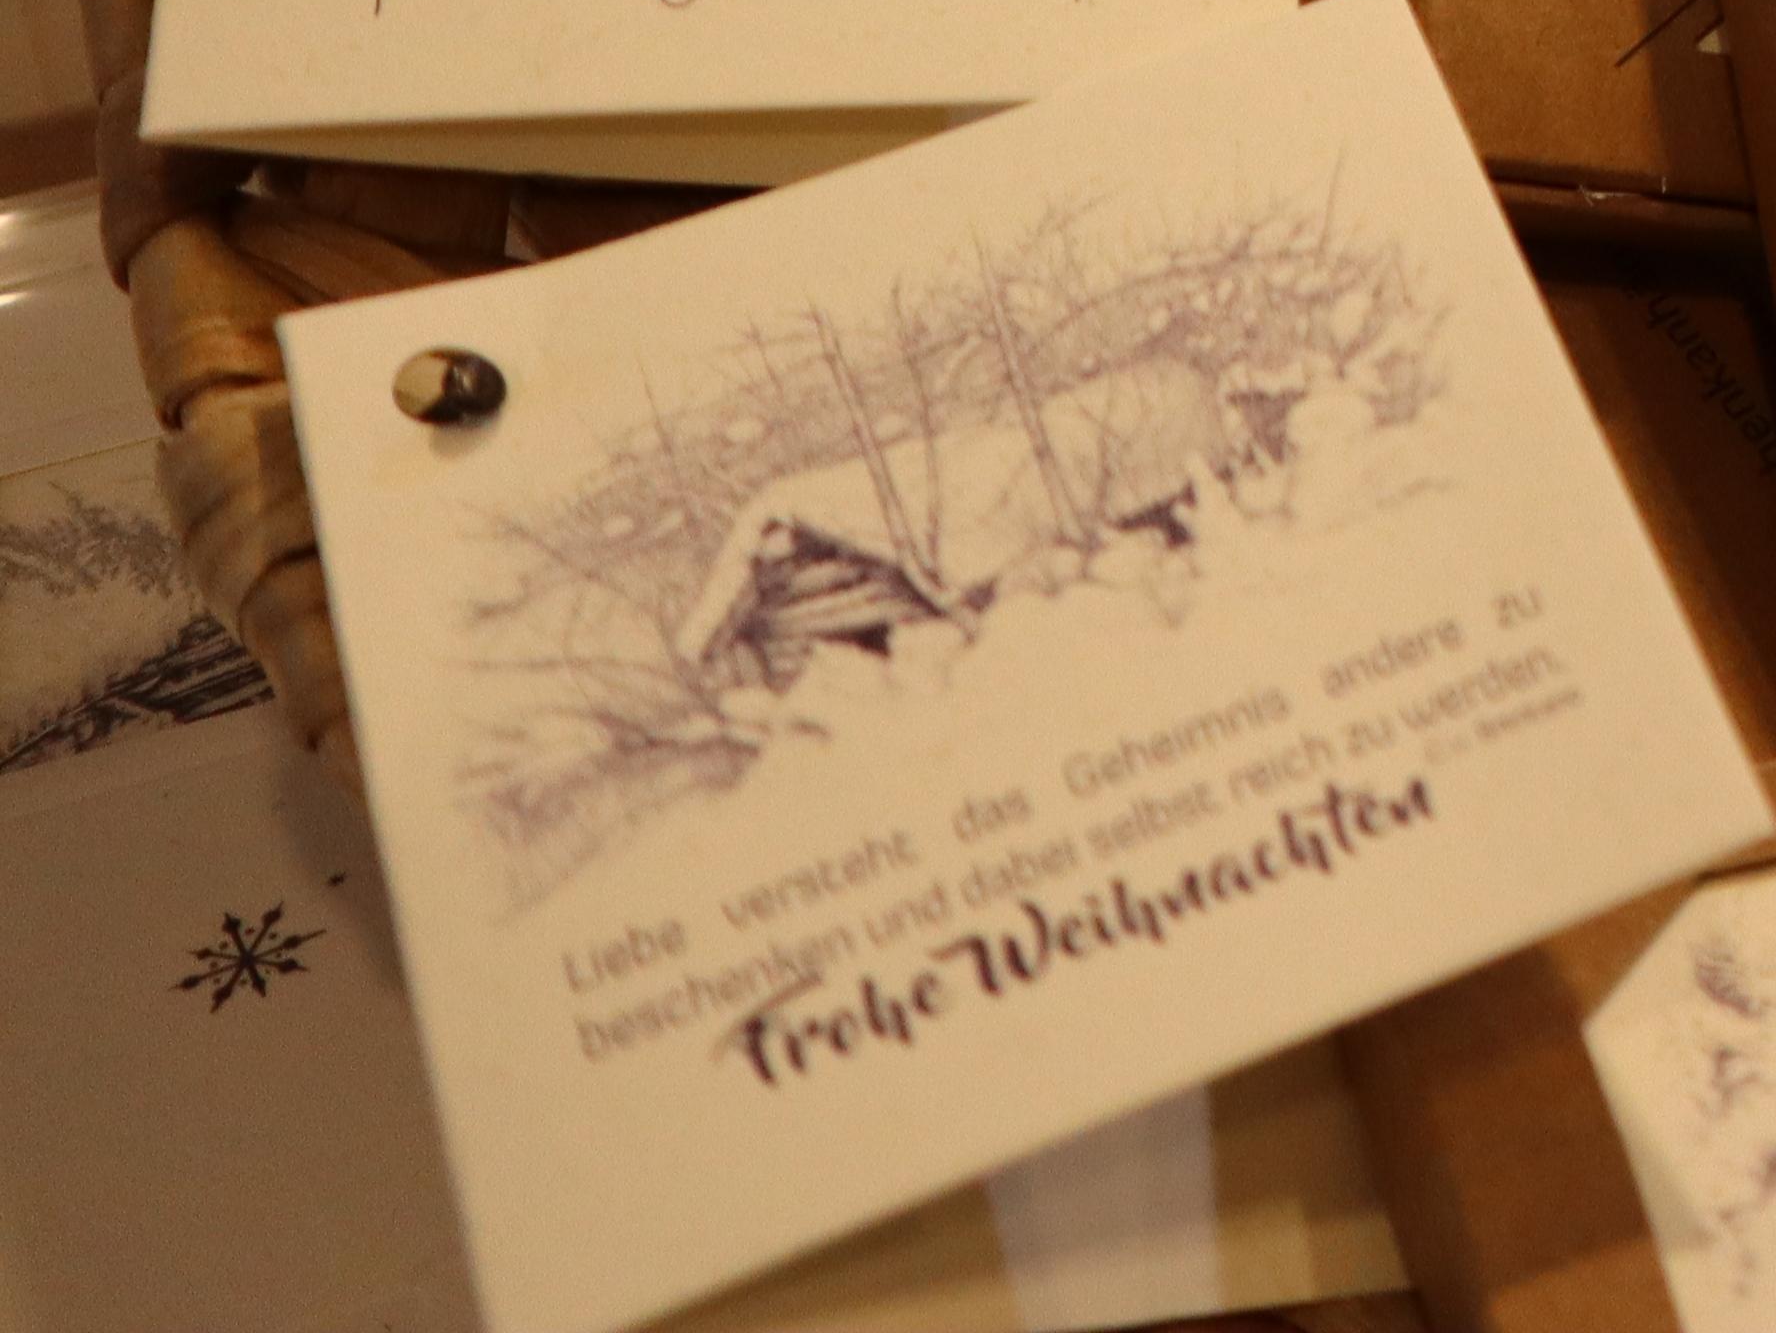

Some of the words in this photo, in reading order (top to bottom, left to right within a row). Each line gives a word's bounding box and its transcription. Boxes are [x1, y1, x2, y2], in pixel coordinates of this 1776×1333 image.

[561, 912, 688, 994] Liebe
[722, 828, 917, 932] versteht
[950, 786, 1035, 848] das
[1062, 687, 1292, 801] Geheimnis
[1321, 618, 1461, 700] andere
[1492, 586, 1543, 631] zu
[573, 921, 857, 1065] beschenken
[863, 878, 954, 951] und
[957, 831, 1081, 911] dabei
[1083, 776, 1217, 873] selbst
[1223, 734, 1336, 806] reich
[1346, 715, 1396, 759] zu
[936, 772, 1438, 1001] Weihnachten
